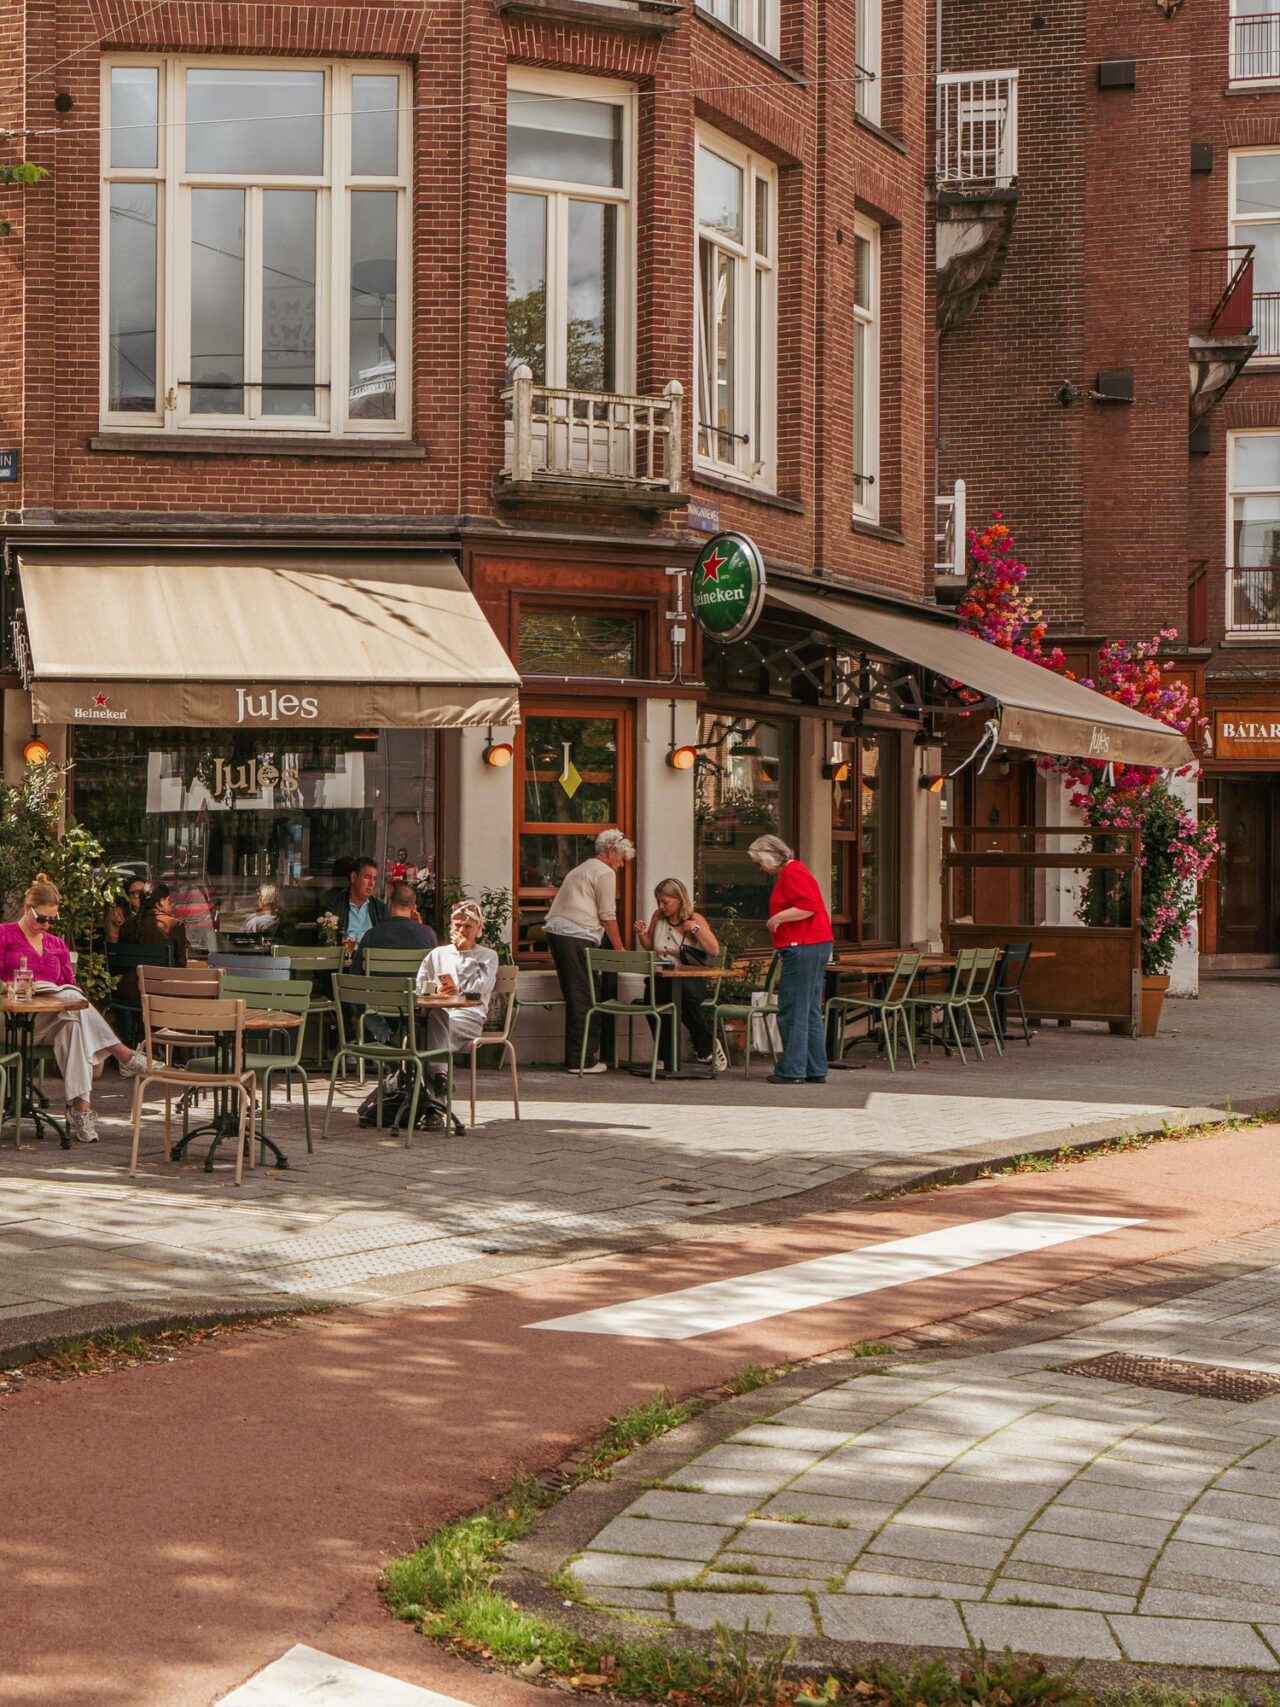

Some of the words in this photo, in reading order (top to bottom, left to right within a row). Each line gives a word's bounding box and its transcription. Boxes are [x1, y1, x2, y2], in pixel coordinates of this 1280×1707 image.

[74, 708, 127, 719] Heineken
[235, 688, 319, 724] Jules
[1089, 726, 1111, 754] Jules
[213, 757, 299, 796] Jules
